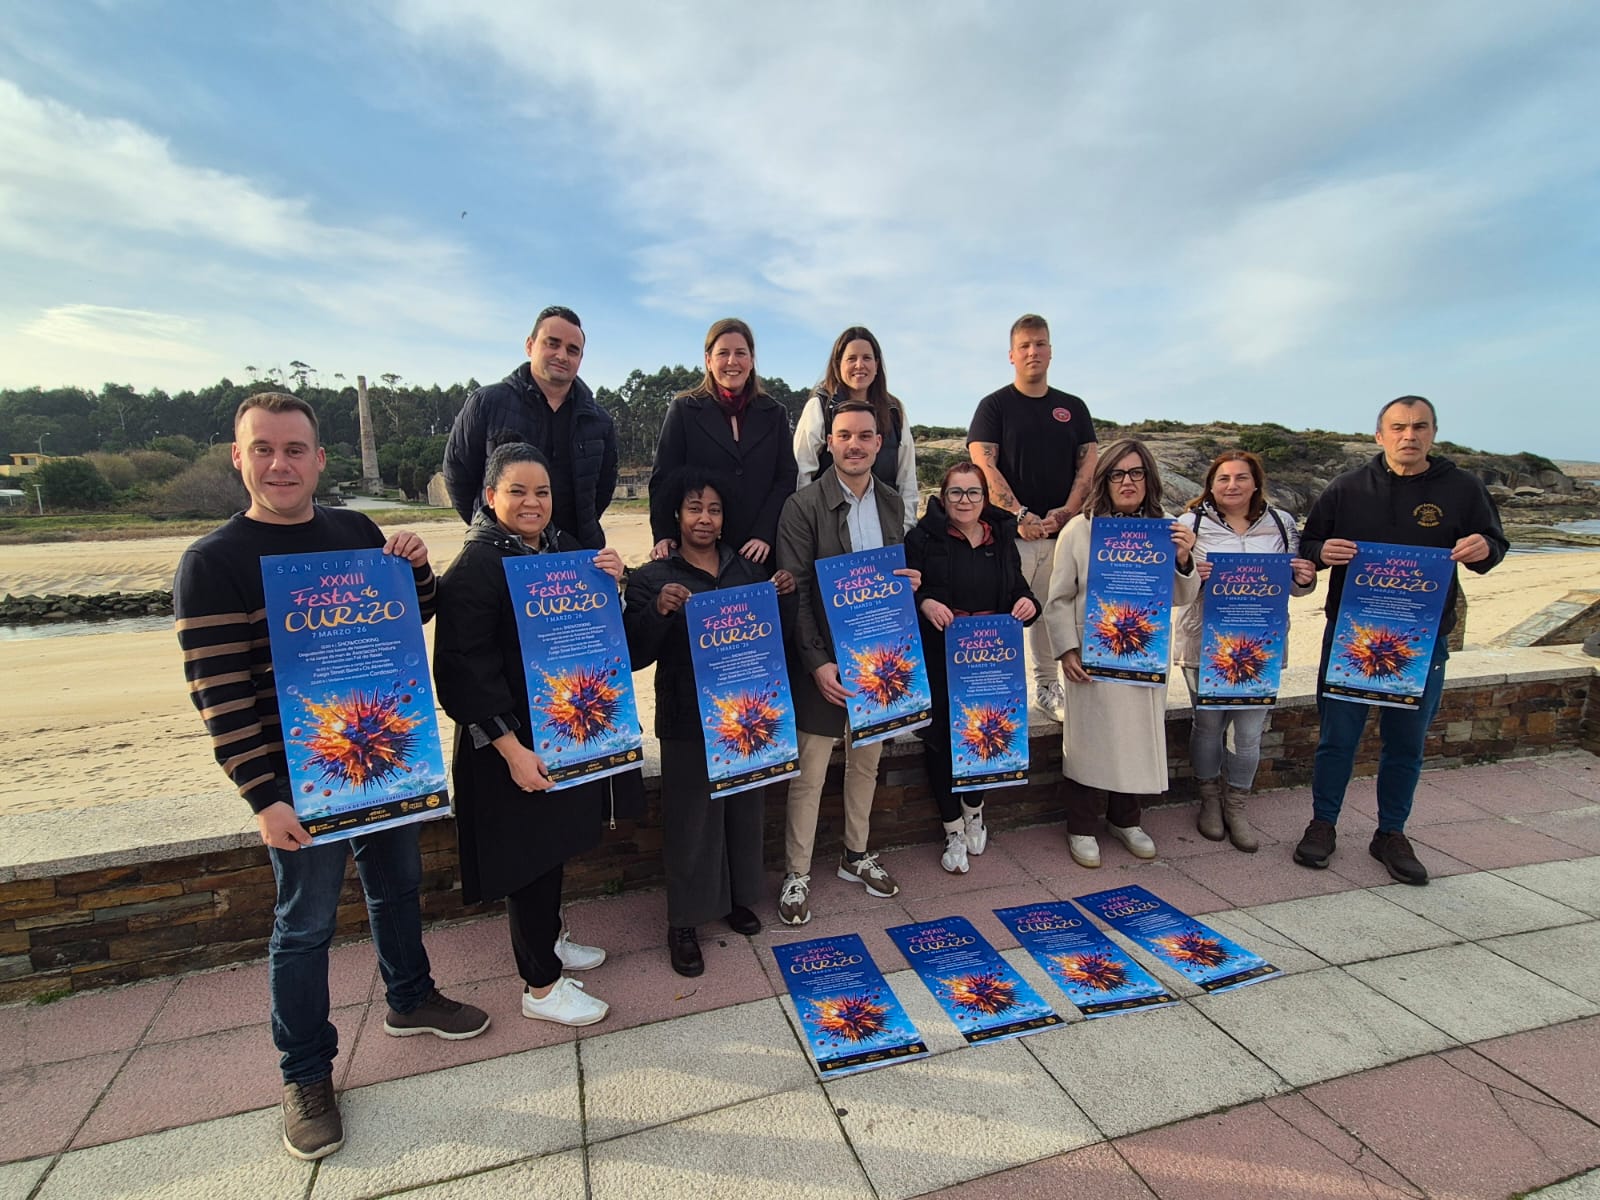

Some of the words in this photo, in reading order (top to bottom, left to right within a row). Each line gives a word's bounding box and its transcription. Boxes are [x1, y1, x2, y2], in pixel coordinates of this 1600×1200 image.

[1104, 537, 1142, 549] Festa
[514, 563, 538, 571] SAN
[546, 557, 592, 568] CIPRIÁ
[1386, 558, 1417, 567] XXXIII
[277, 564, 311, 574] SAN
[849, 566, 876, 576] XXXIII
[1364, 563, 1410, 576] Festa
[320, 572, 364, 587] XXXIII
[545, 571, 576, 582] XXXIII
[834, 577, 875, 591] Festa
[874, 573, 884, 581] do
[1219, 571, 1257, 583] Festa
[526, 582, 576, 597] Festa
[575, 580, 587, 590] do
[291, 587, 361, 606] Festa
[361, 585, 378, 598] do
[695, 599, 715, 607] SAN
[720, 603, 747, 615] XXXIII
[702, 615, 746, 629] Festa
[745, 612, 755, 621] do
[319, 629, 351, 638] MARZO
[973, 629, 997, 637] XXXIII
[958, 637, 994, 649] Festa
[907, 936, 947, 944] Festa
[792, 953, 834, 963] Festa
